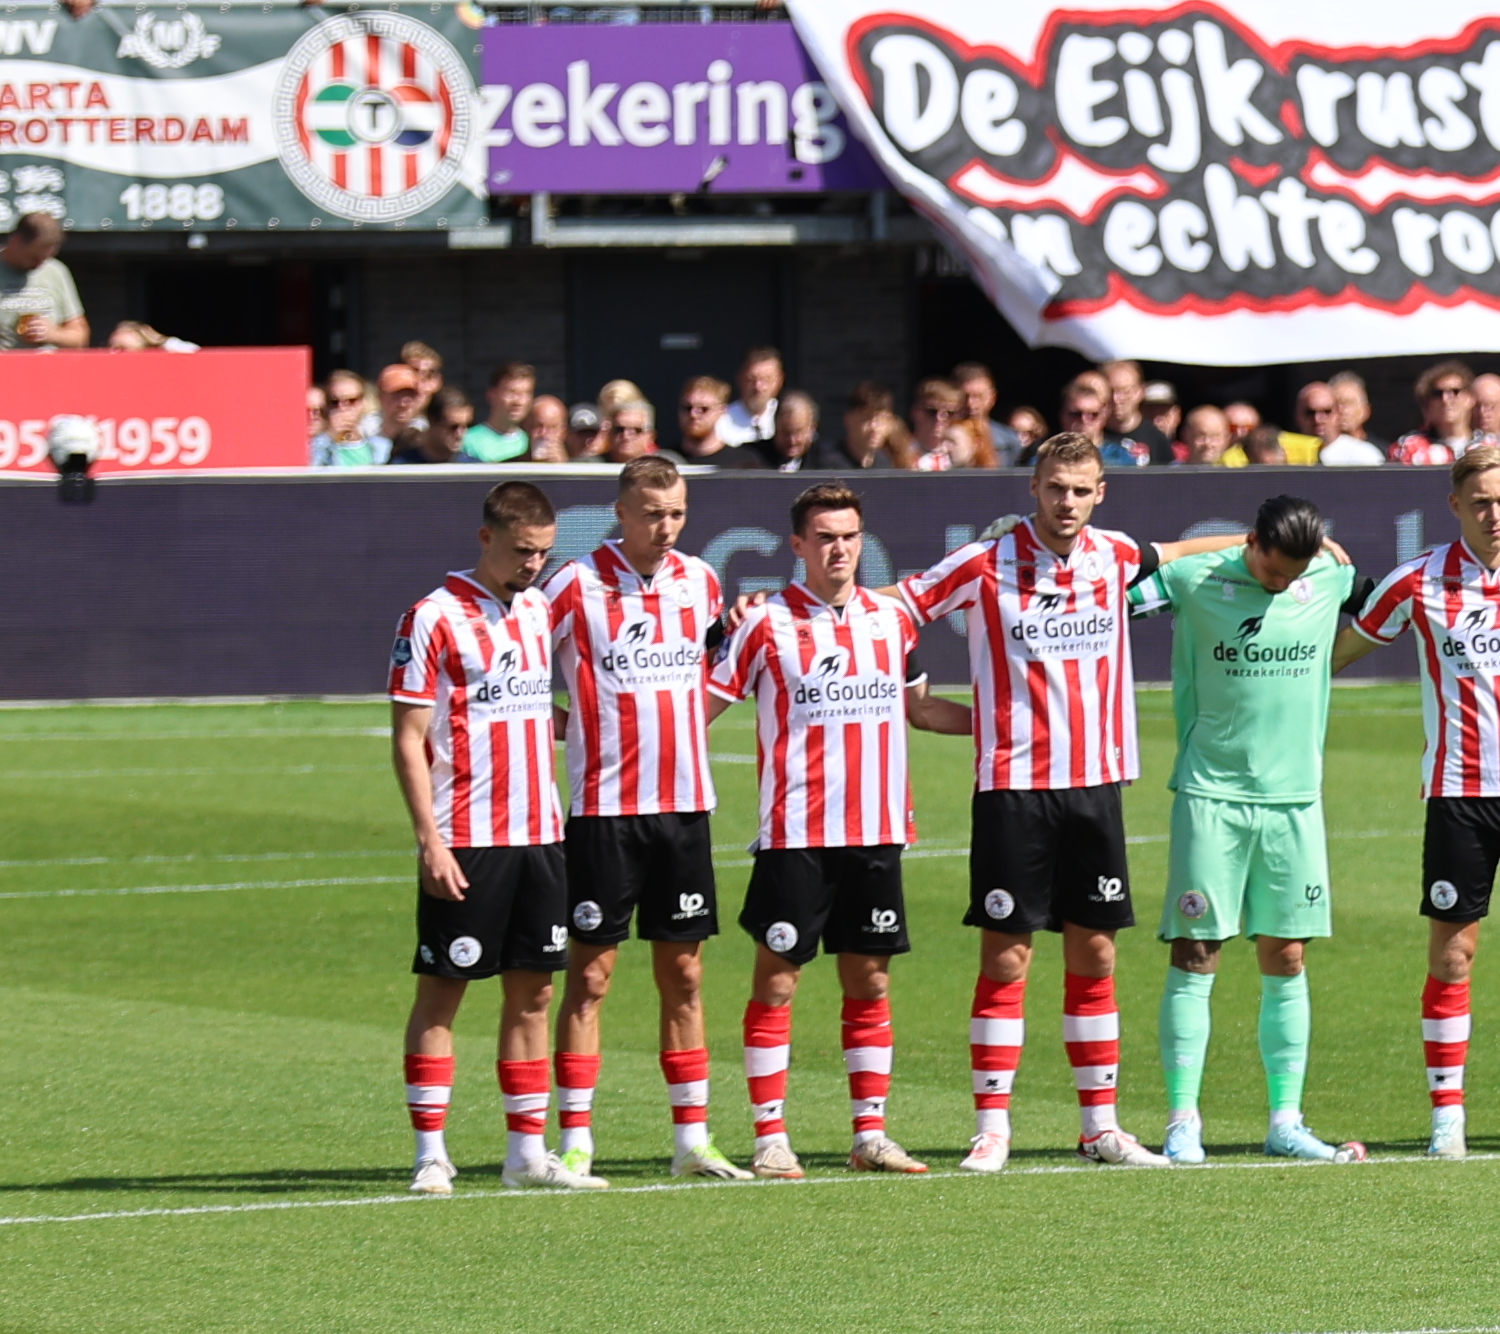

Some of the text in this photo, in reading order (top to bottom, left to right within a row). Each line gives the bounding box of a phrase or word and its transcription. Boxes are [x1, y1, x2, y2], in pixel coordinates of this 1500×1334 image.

[873, 33, 1028, 155] De
[1056, 21, 1279, 173] Eijk
[362, 101, 387, 130] T
[0, 116, 249, 144] ROTTERDAM
[119, 182, 226, 221] 1888
[1105, 169, 1379, 276] echte
[1011, 613, 1114, 641] de Goudse
[602, 643, 702, 673] de Goudse
[1213, 639, 1317, 663] de Goudse
[1442, 634, 1467, 656] de
[476, 682, 502, 702] de
[795, 677, 898, 705] de Goudse
